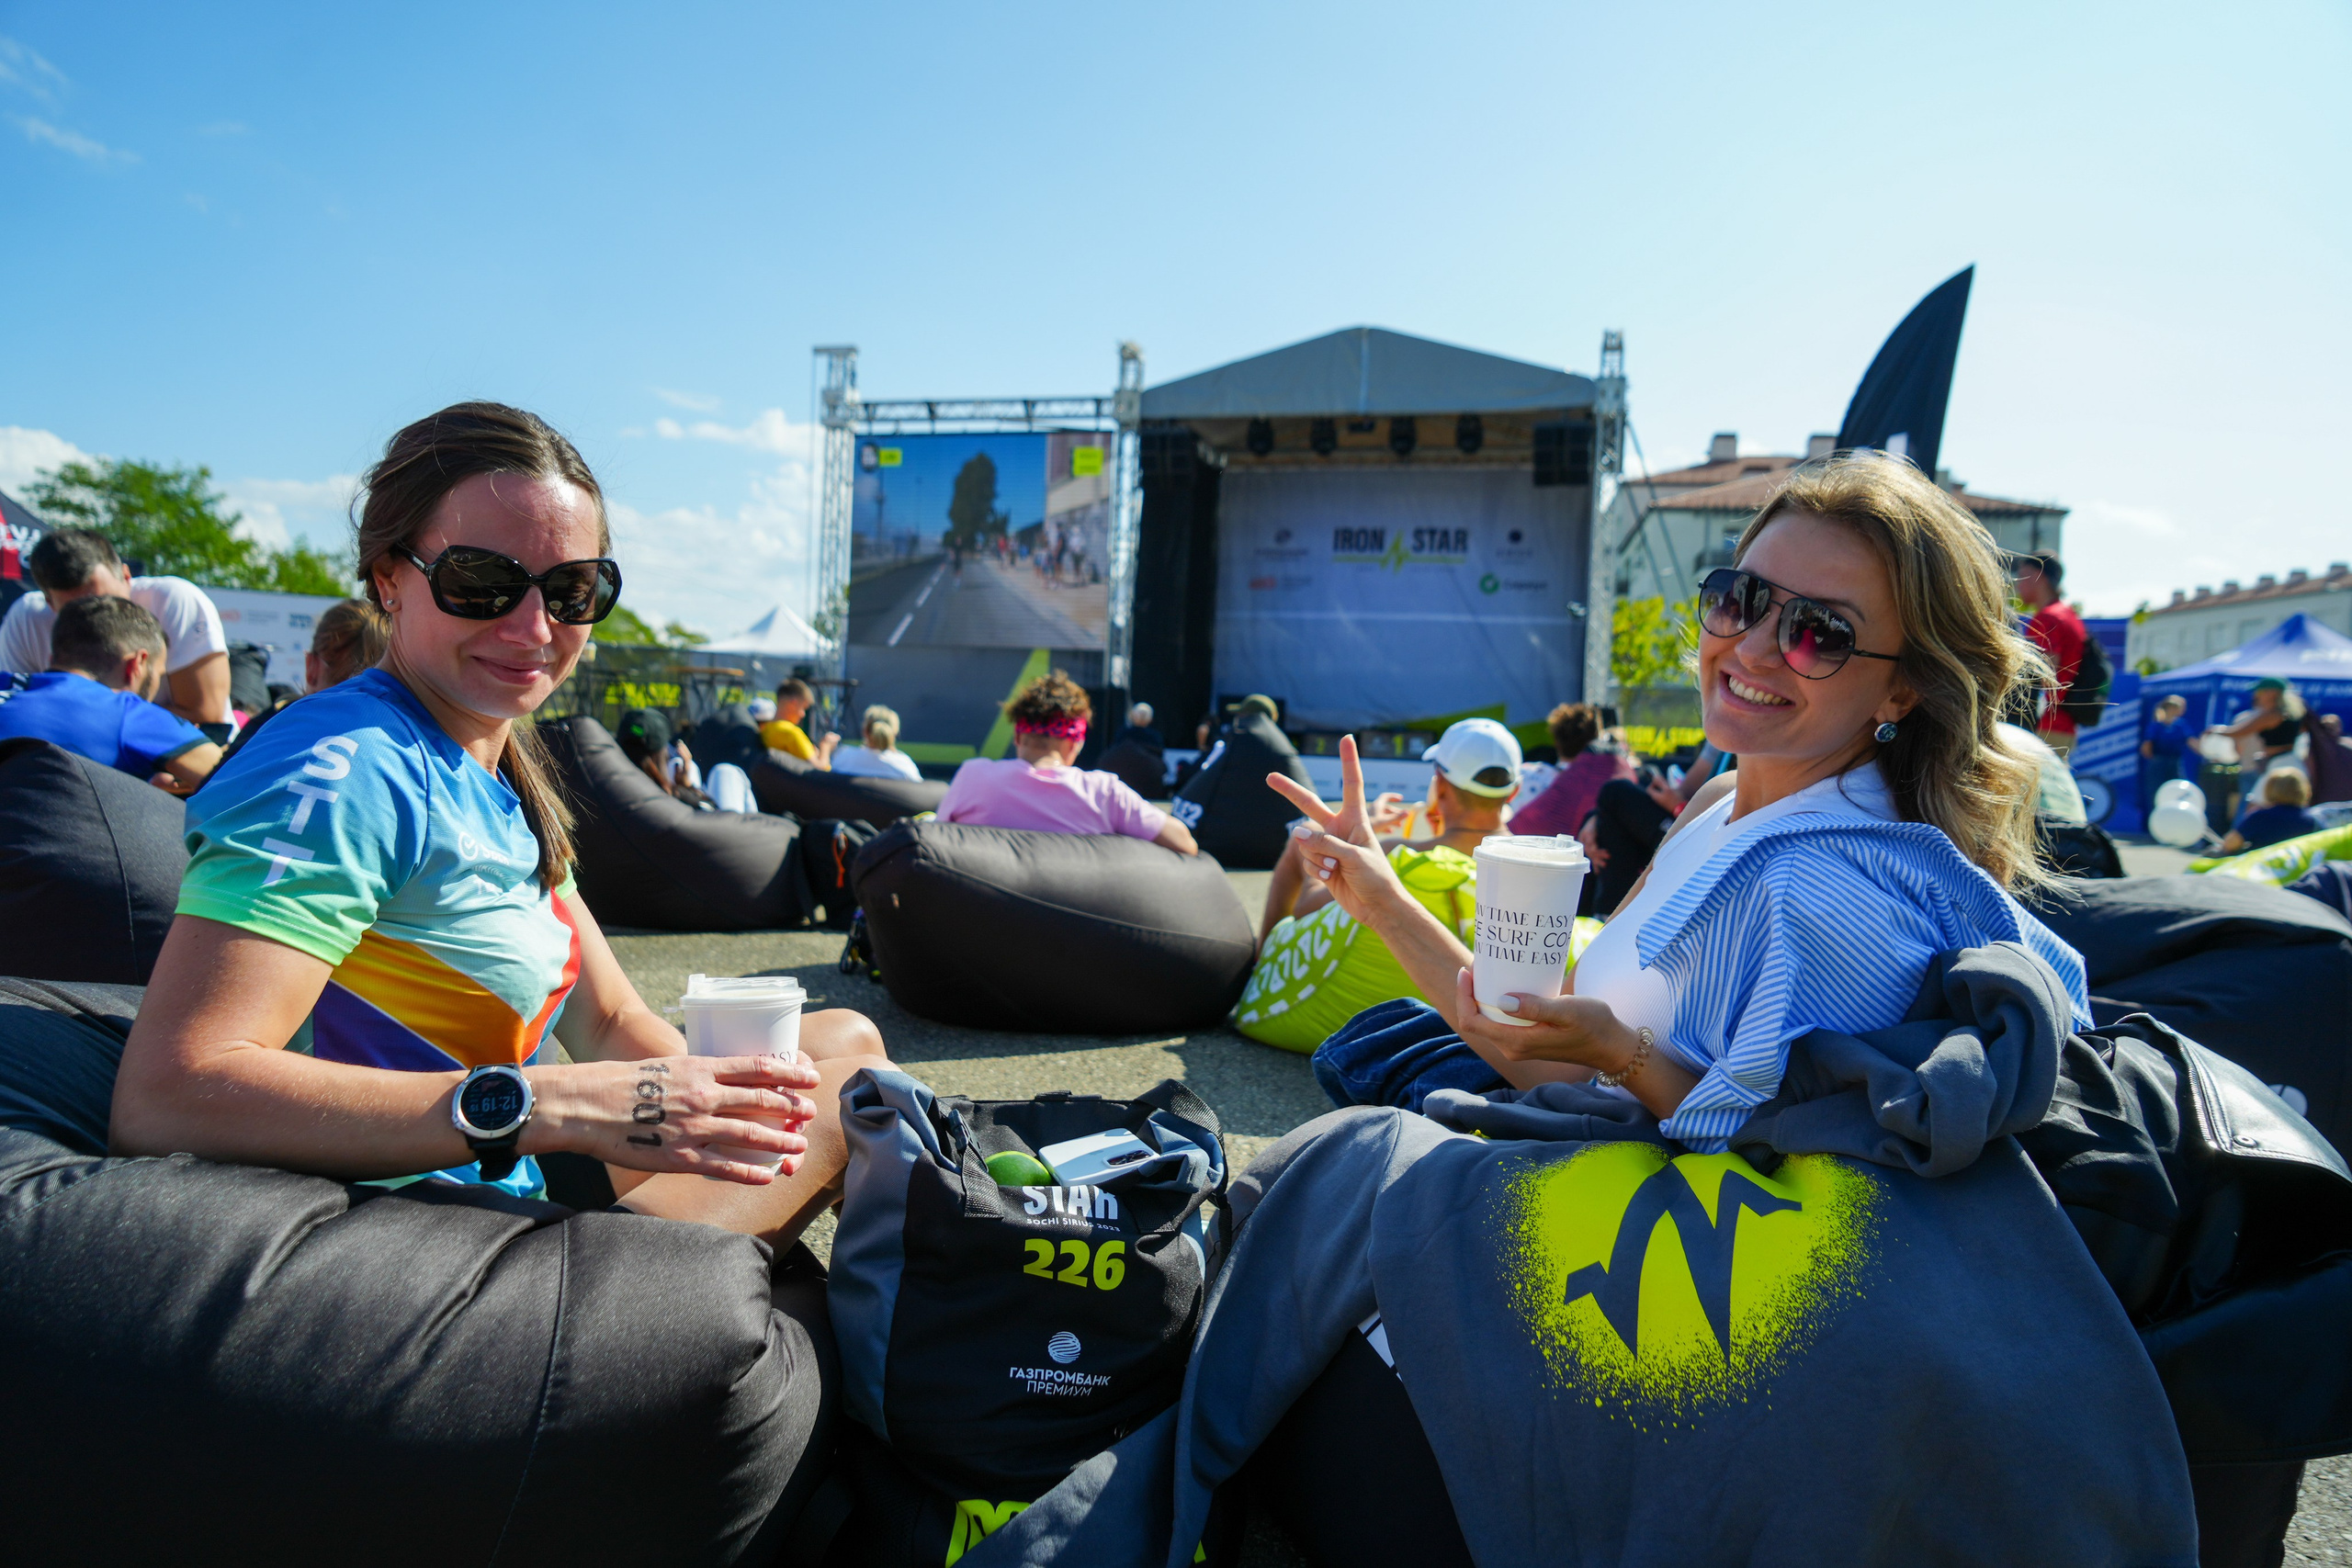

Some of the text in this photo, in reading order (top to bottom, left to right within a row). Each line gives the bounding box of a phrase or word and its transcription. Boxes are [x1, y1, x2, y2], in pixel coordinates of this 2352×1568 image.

[1333, 525, 1469, 554] IRON STAR
[1487, 907, 1529, 927] TIME
[1535, 914, 1571, 929] EASY
[1487, 925, 1537, 946] SURF
[1486, 944, 1525, 964] TIME
[1531, 951, 1565, 965] EASY
[1026, 1217, 1121, 1232] SOCHI SIRIUS 2023
[1023, 1238, 1125, 1291] 226
[1009, 1367, 1112, 1386] ГАЗПРОМБАНК
[1026, 1380, 1093, 1396] ПРЕМИУМ
